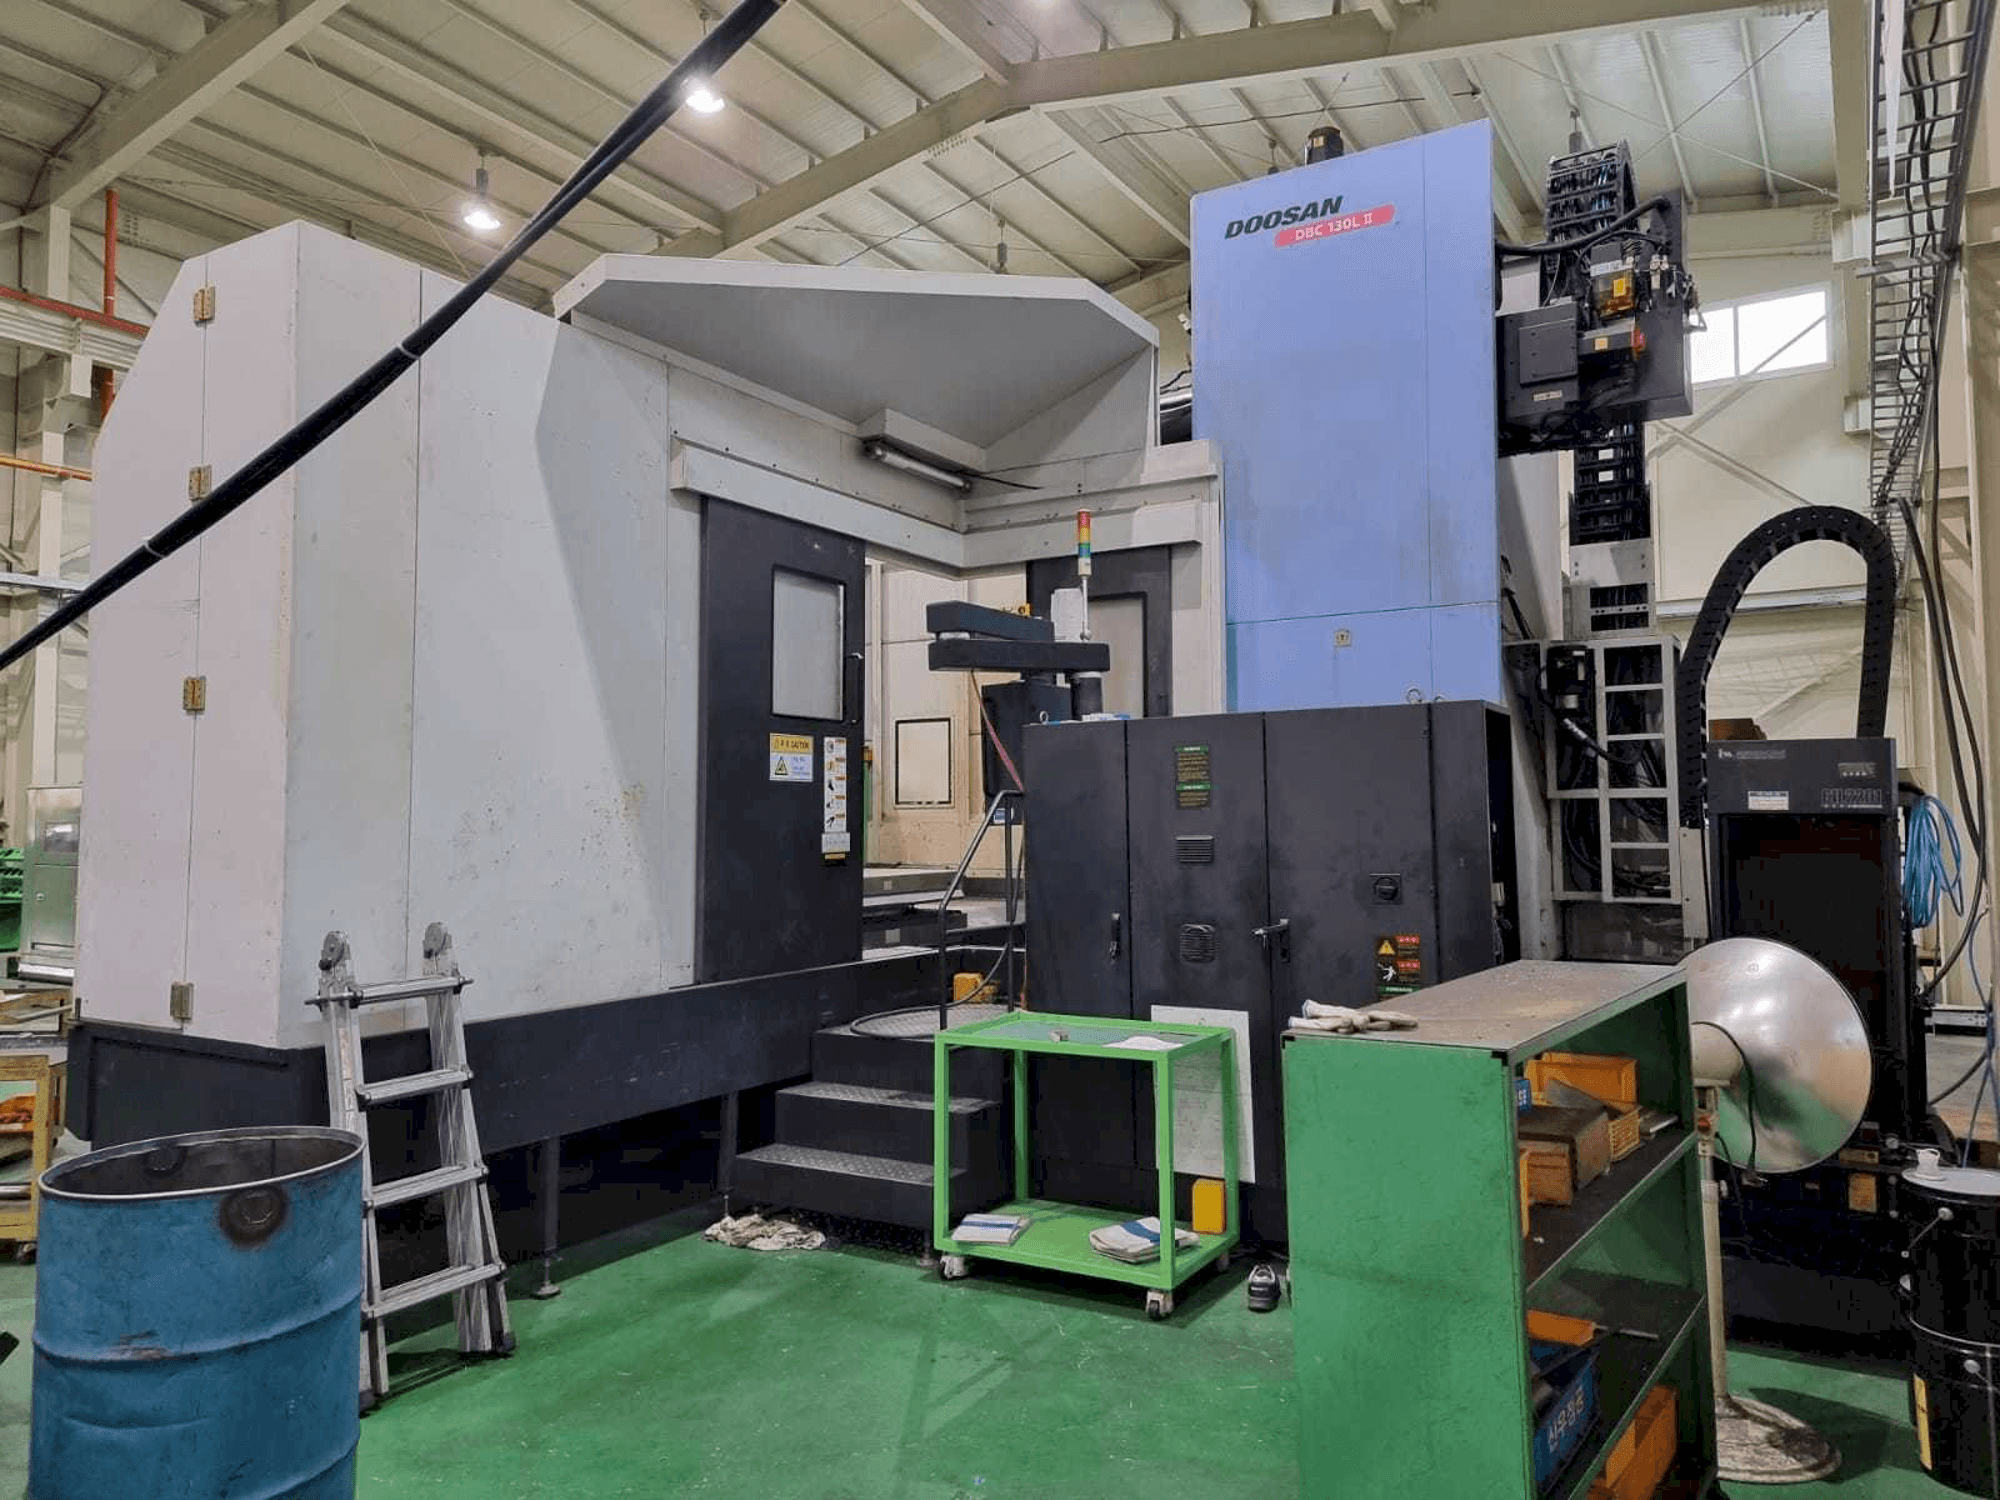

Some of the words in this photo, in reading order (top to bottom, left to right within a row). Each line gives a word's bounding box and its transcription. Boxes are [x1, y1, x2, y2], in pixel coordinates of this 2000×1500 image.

[1225, 194, 1344, 240] DOOSAN
[1295, 223, 1323, 241] DBC
[1327, 216, 1361, 233] 130L
